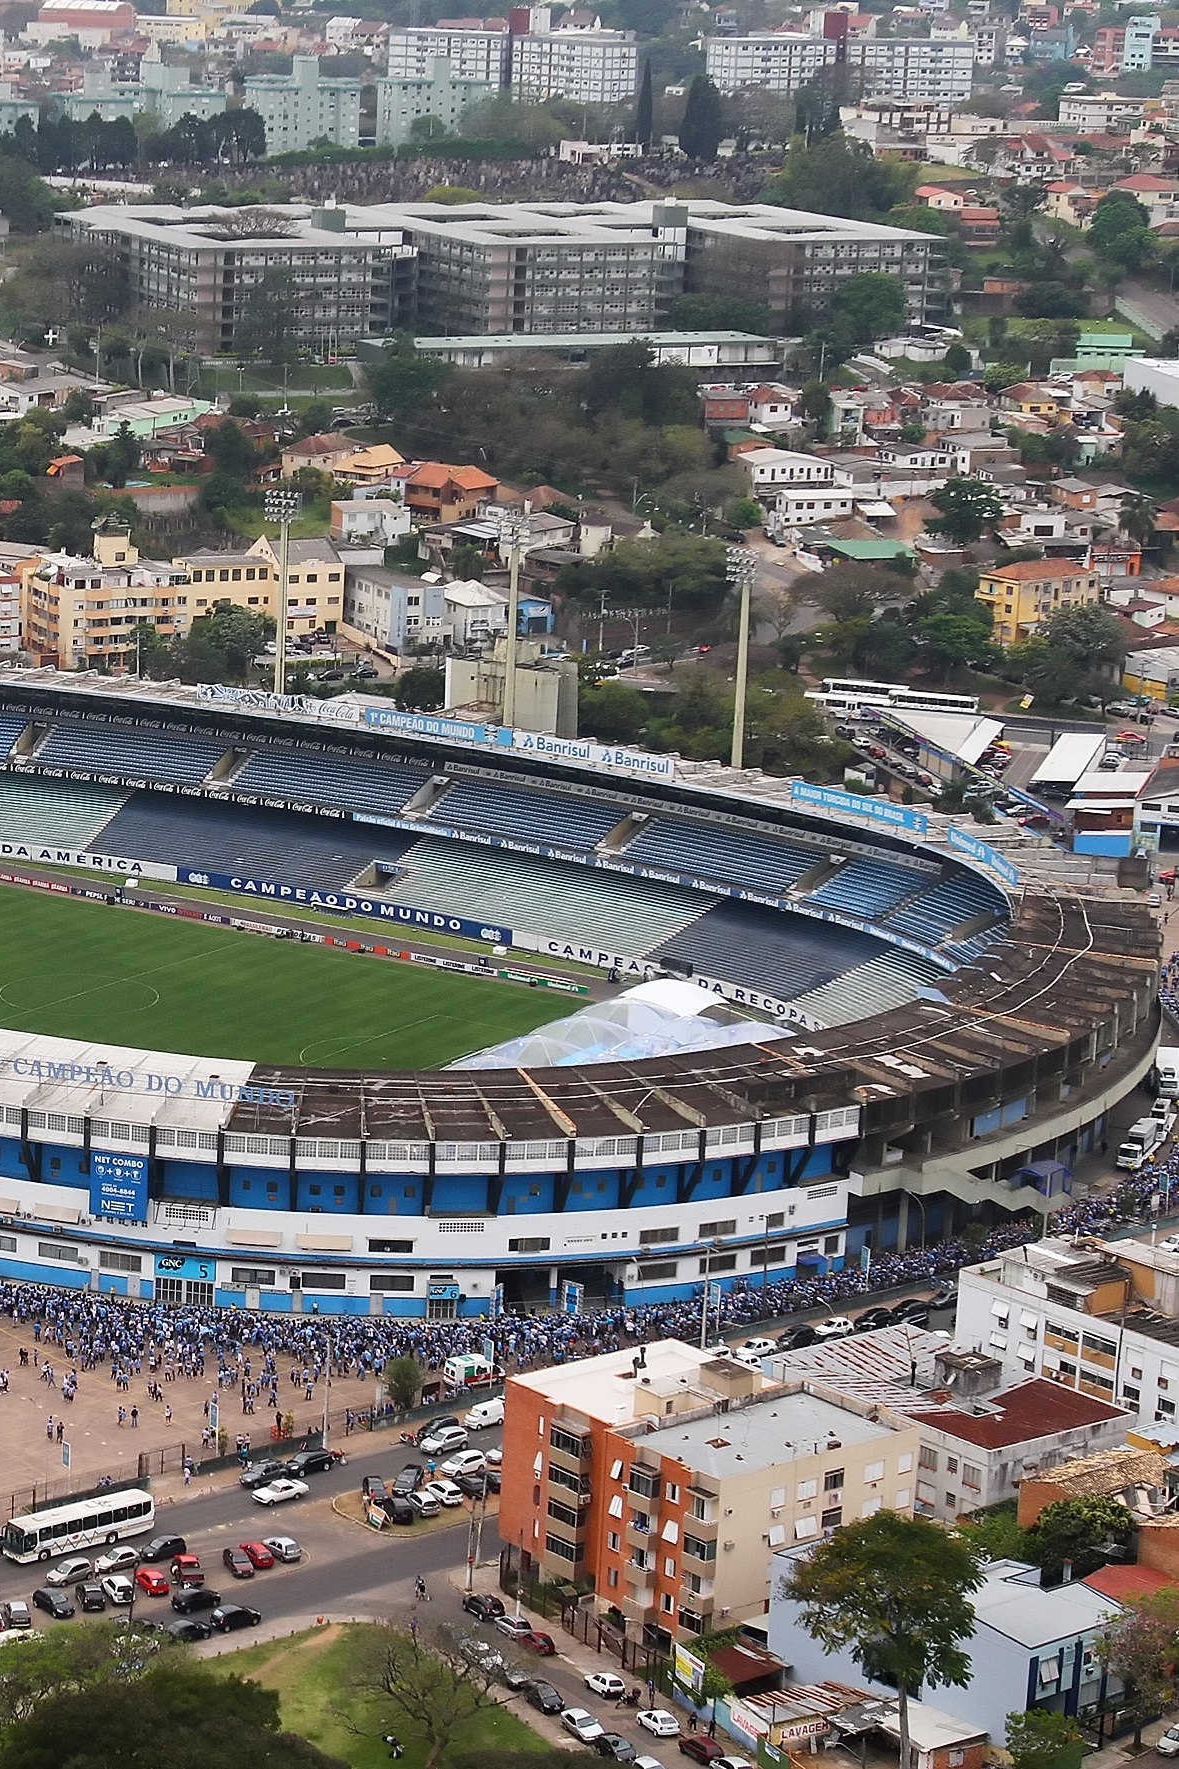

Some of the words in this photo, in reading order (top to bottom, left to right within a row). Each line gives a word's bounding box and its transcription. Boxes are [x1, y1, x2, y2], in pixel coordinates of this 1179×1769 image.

[319, 703, 354, 719] Coca-Cola
[379, 714, 423, 730] CAMPEÃO
[427, 721, 439, 734] DO
[441, 725, 475, 739] MUNDO
[536, 736, 590, 759] Banrisul
[615, 752, 669, 774] Banrisul
[453, 764, 480, 775] Banrisul
[499, 772, 526, 783] Banrisul
[545, 780, 571, 792] Banrisul
[591, 788, 618, 800] Banrisul
[637, 797, 664, 809] Banrisul
[683, 806, 710, 818] Banrisul
[731, 816, 758, 829] Banrisul
[778, 827, 805, 839] Banrisul
[2, 844, 28, 856] DA
[40, 848, 143, 874] AMÉRICA
[459, 830, 491, 845] Banrisul
[508, 841, 540, 854] Banrisul
[555, 850, 587, 864] Banrisul
[602, 860, 634, 874] Banrisul
[648, 870, 680, 884] Banrisul
[699, 880, 731, 895] Banrisul
[747, 891, 779, 907] Banrisul
[792, 903, 823, 919] Banrisul
[834, 914, 864, 930] Banrisul
[159, 905, 176, 914] VIVO
[231, 877, 339, 906] CAMPEÃO
[345, 897, 373, 912] DO
[380, 905, 461, 931] MUNDO
[333, 938, 346, 947] Itaú
[386, 948, 400, 958] Itaú
[414, 954, 436, 964] LISTERINE
[442, 960, 466, 970] LISTERINE
[472, 966, 494, 975] LISTERINE
[508, 973, 530, 982] Unimed
[547, 981, 571, 991] Unimed
[548, 941, 653, 973] CAMPEÃO
[698, 977, 723, 994] DA
[736, 988, 807, 1024] RECOPA
[13, 1057, 133, 1088] CAMPEÃO
[147, 1074, 182, 1094] DO
[194, 1080, 294, 1107] MUNDO
[95, 1156, 110, 1164] NET
[112, 1158, 143, 1168] COMBO
[101, 1200, 135, 1212] NET
[162, 1258, 182, 1268] GNC
[199, 1265, 208, 1278] 5
[450, 1290, 457, 1298] 6
[781, 1721, 829, 1738] LAVAGEM
